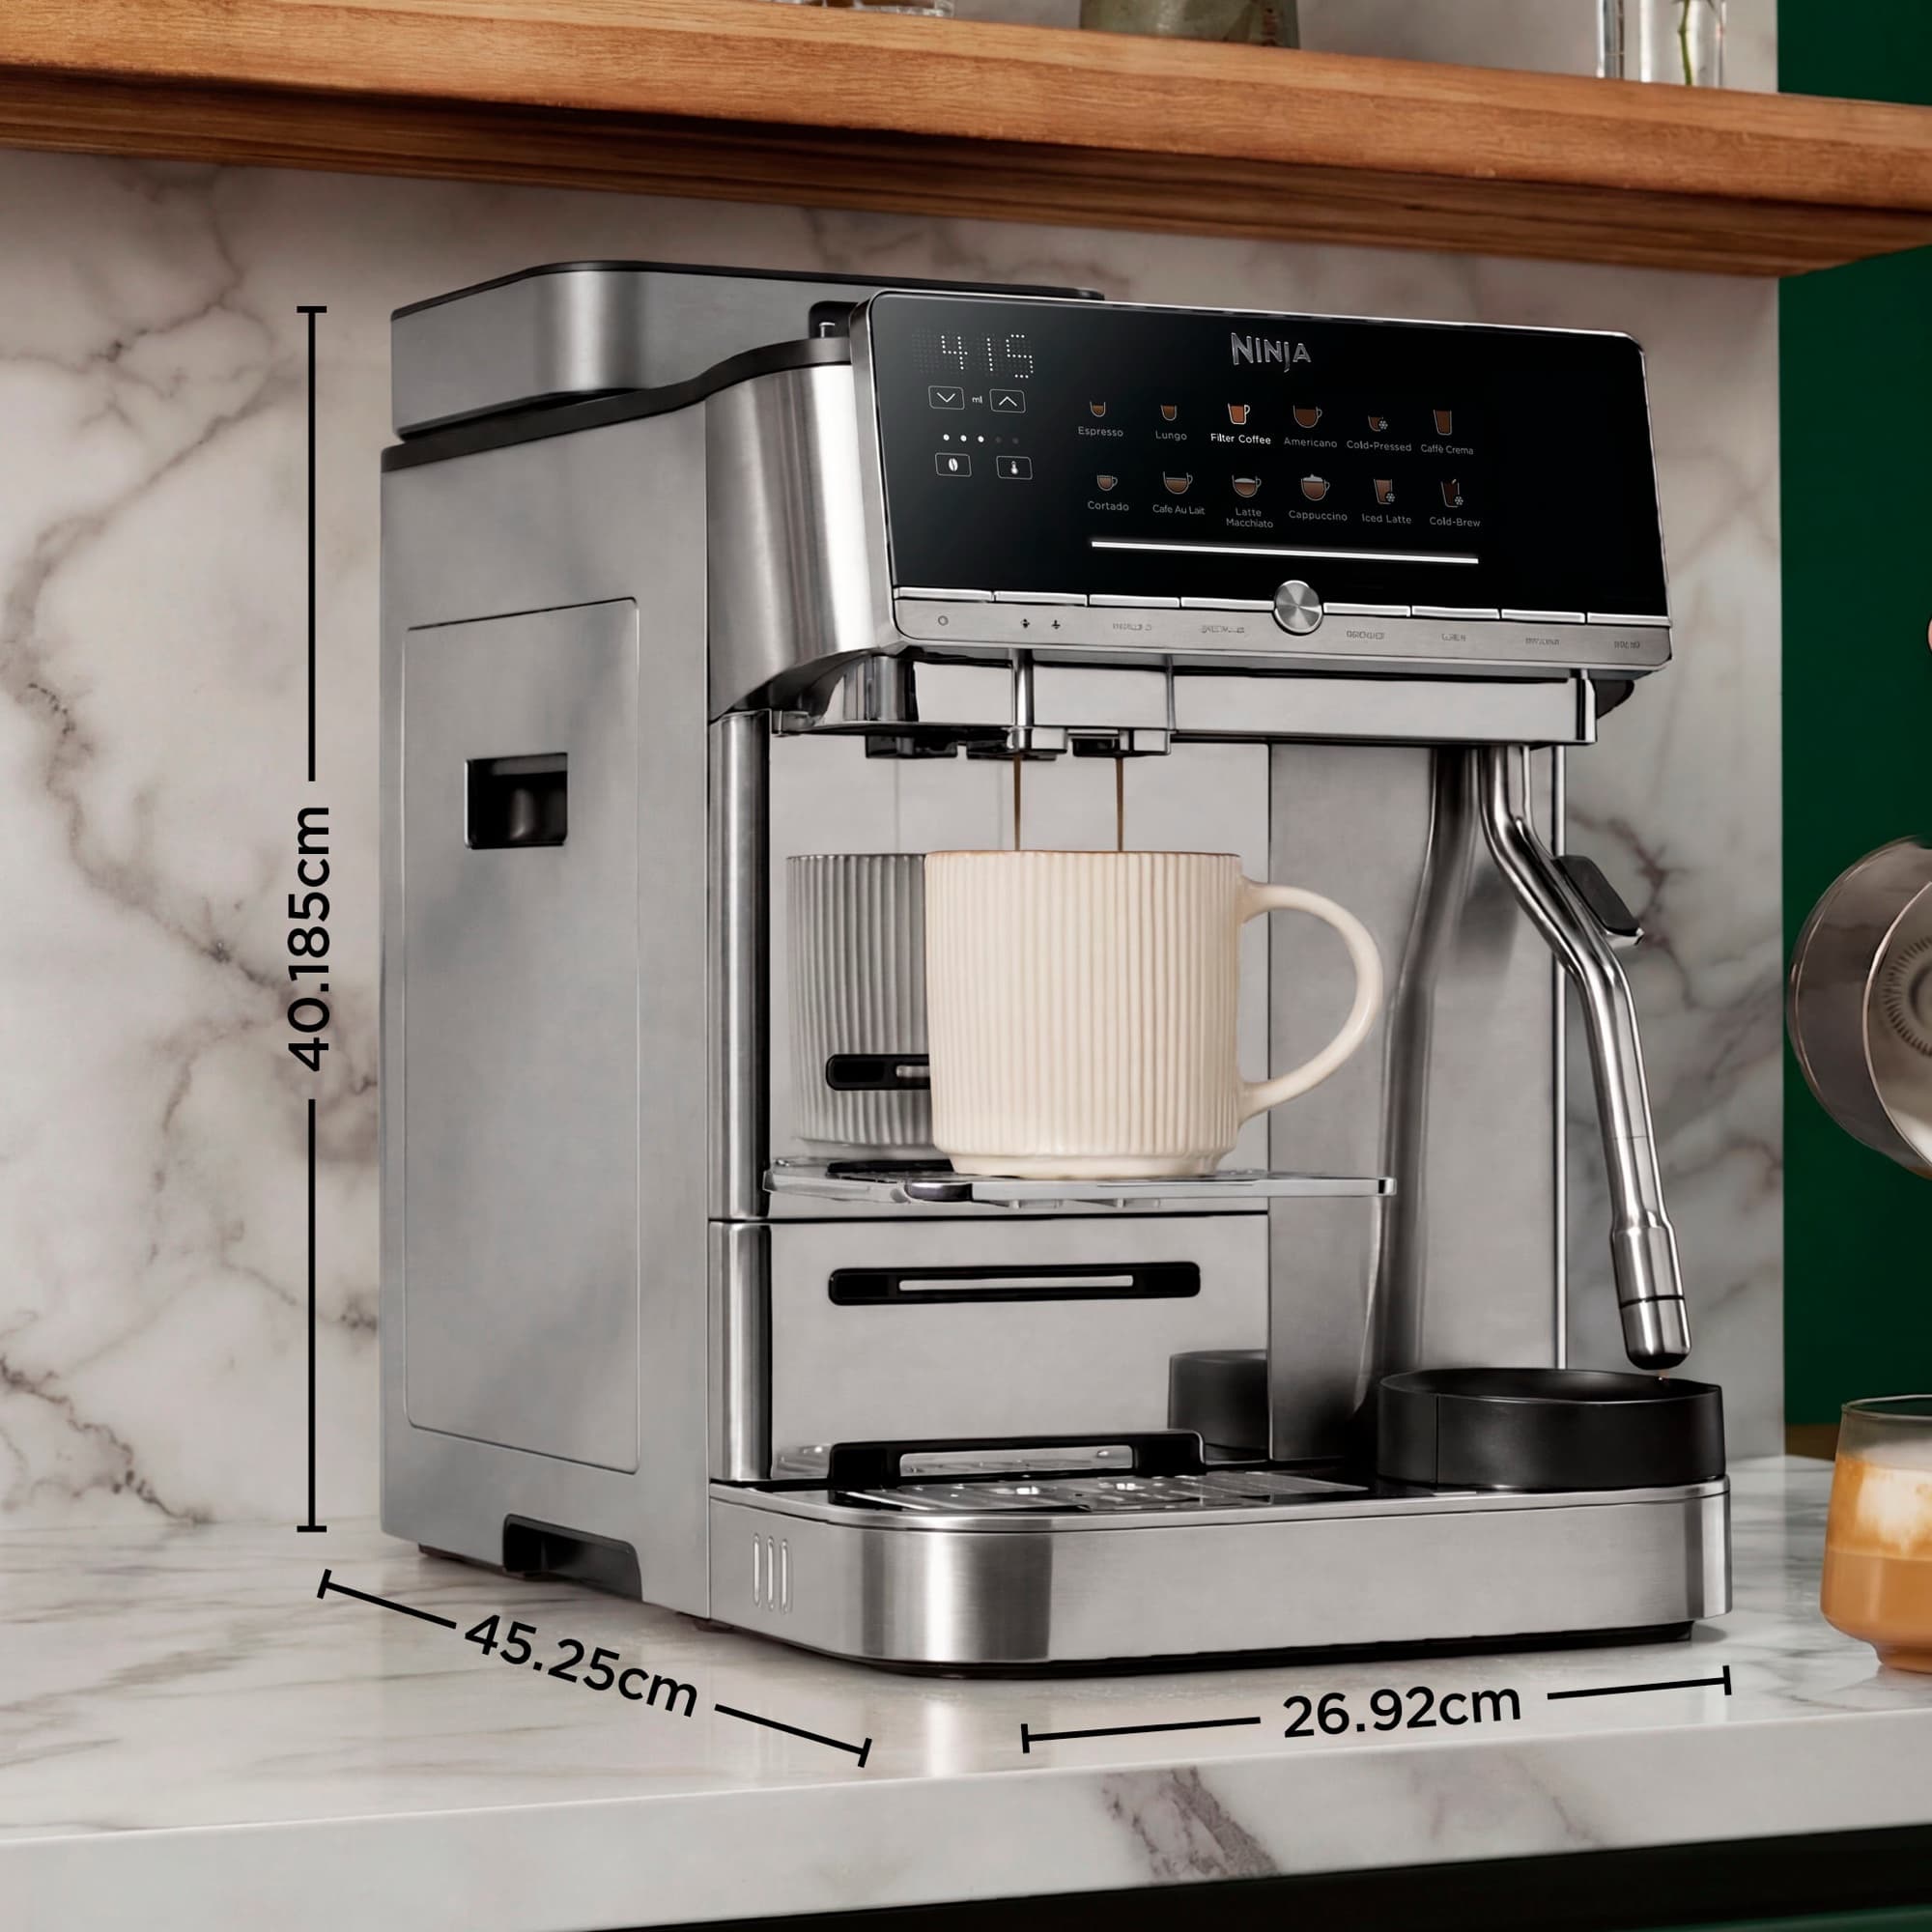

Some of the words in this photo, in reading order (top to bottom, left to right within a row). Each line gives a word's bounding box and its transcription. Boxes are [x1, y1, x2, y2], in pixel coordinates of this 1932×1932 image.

[939, 332, 1035, 380] 415
[1230, 331, 1313, 374] NINJA
[971, 394, 983, 405] ml
[1077, 424, 1124, 439] Espresso
[1154, 429, 1189, 441] Lungo
[1209, 432, 1236, 444] Filter
[1237, 434, 1272, 446] Coffee
[1283, 437, 1339, 449] Americano
[1346, 440, 1413, 453] Cold-Pressed
[1445, 444, 1475, 456] Crema
[1087, 499, 1130, 513] Cortado
[1175, 504, 1188, 516] Au
[1189, 505, 1207, 516] Lait
[1235, 507, 1263, 518] Latte
[1288, 508, 1349, 523] Cappuccino
[1360, 512, 1383, 524] Iced
[1385, 514, 1413, 526] Latte
[1429, 515, 1482, 528] Cold-Brew
[1225, 517, 1275, 529] Macchiato
